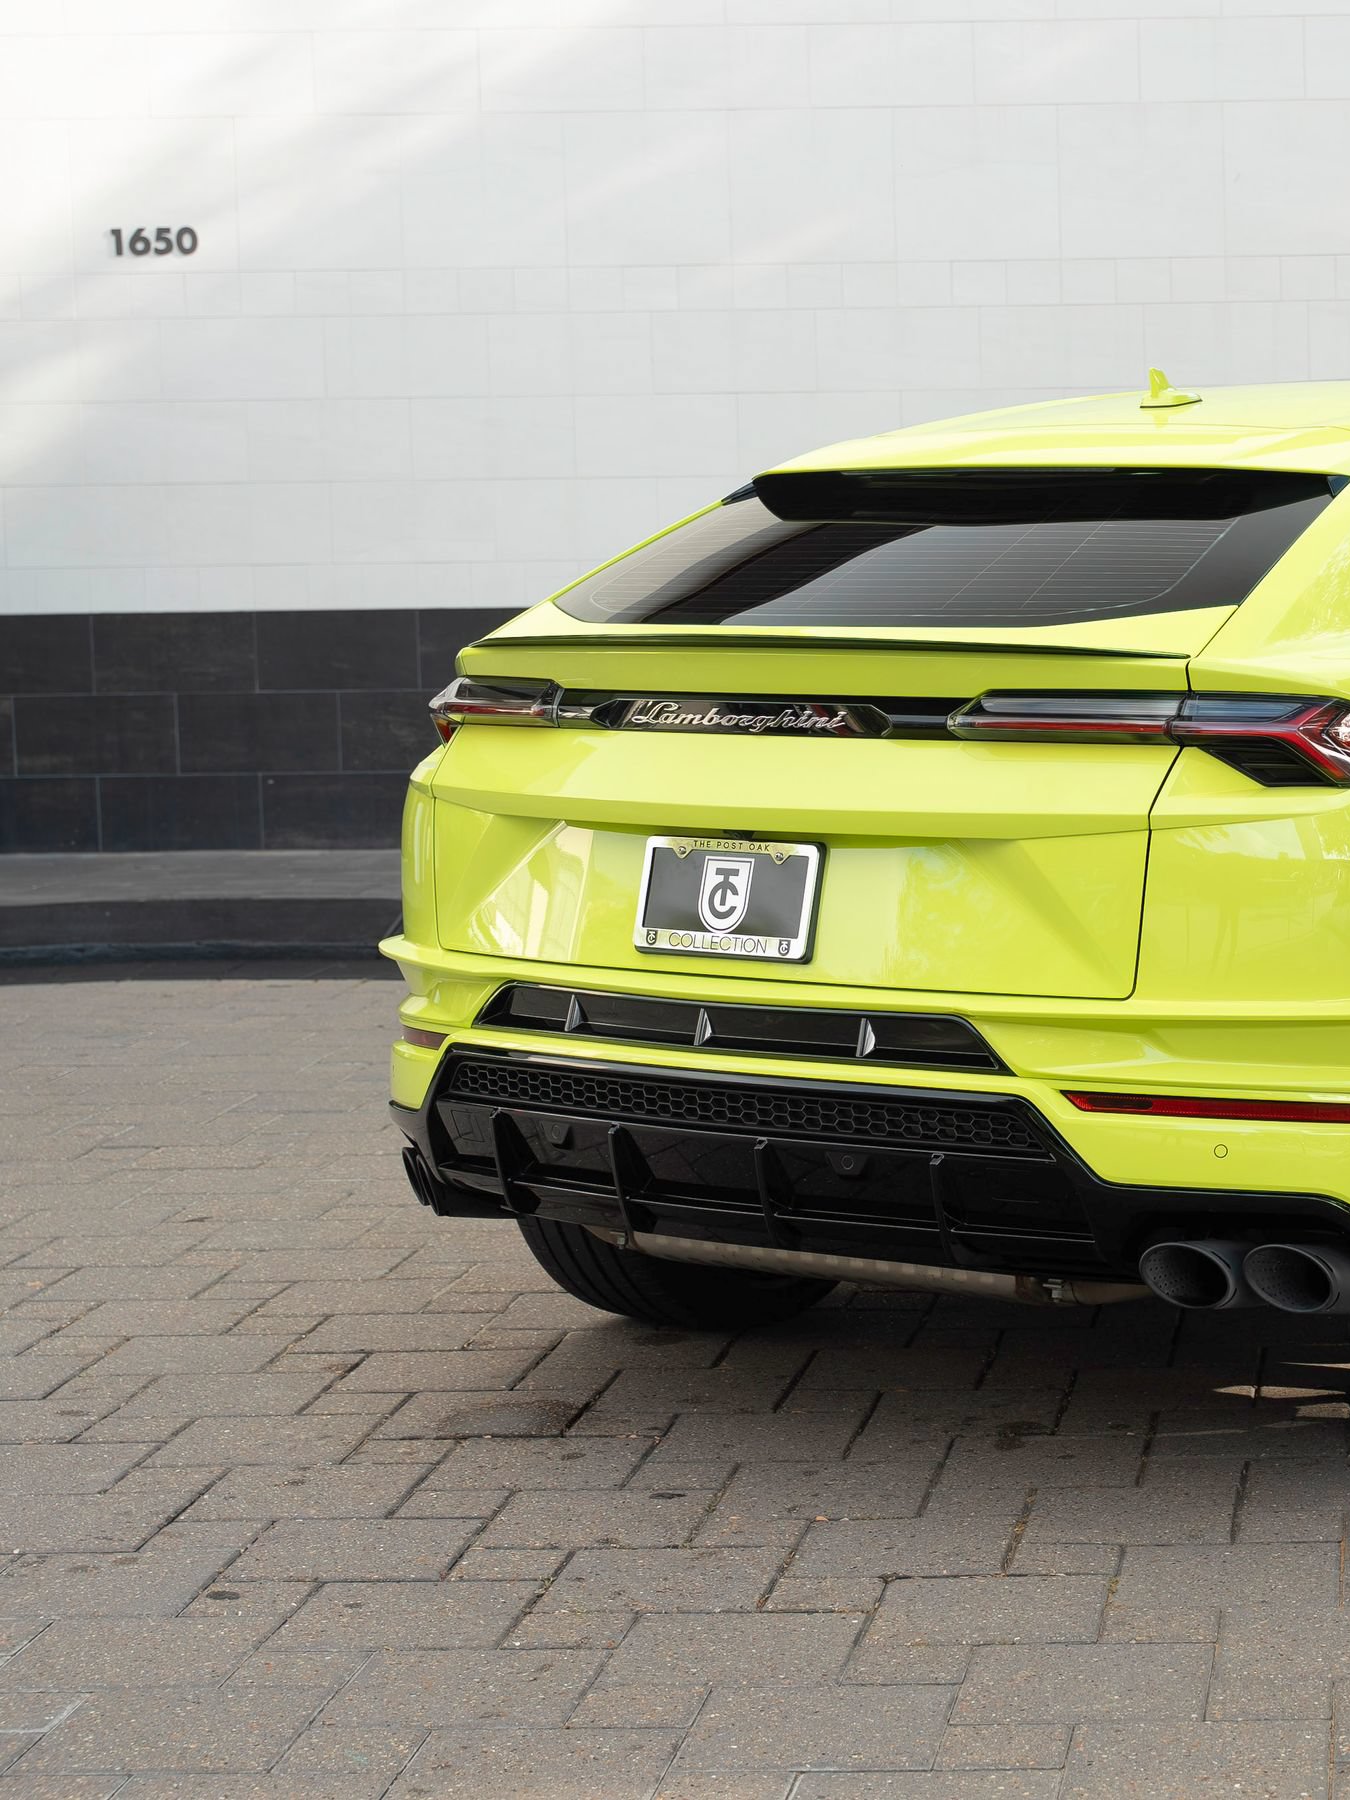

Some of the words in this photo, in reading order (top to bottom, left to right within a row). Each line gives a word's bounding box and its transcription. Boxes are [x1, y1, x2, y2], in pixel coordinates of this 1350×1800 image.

[110, 226, 198, 256] 1650
[631, 701, 847, 732] Lamborghini
[693, 839, 711, 849] THE
[716, 841, 743, 850] POST
[748, 843, 770, 852] OAK
[668, 932, 768, 954] COLLECTION
